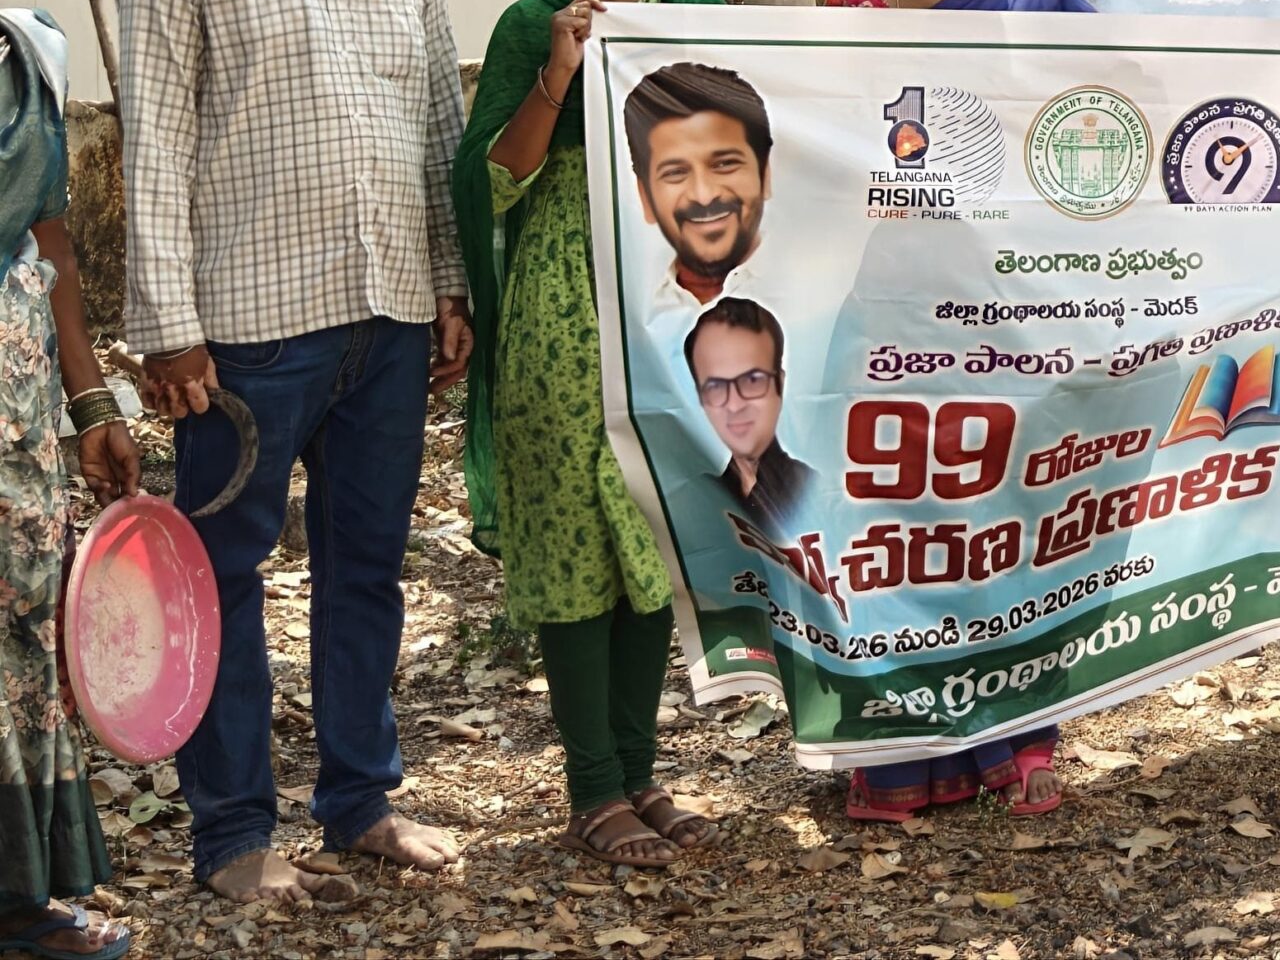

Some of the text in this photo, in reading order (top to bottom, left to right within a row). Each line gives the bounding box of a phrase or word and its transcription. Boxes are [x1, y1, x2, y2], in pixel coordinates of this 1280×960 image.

[1034, 96, 1145, 151] GOVERNMENT OF TELANGANA
[1166, 133, 1184, 165] ప్రజా
[1183, 103, 1221, 134] పాలన
[1232, 101, 1266, 121] ప్రగతి
[868, 188, 955, 207] RISING
[870, 171, 952, 183] TELANGANA
[867, 209, 909, 219] CURE
[922, 210, 962, 220] PURE
[973, 210, 1010, 219] RARE
[995, 247, 1204, 281] తెలంగాణ ప్రభుత్వం
[935, 302, 980, 326] జిల్లా
[982, 299, 1081, 325] గ్రంథాలయ
[1085, 297, 1126, 329] సంస్థ
[1143, 295, 1199, 317] మెదక్
[867, 344, 956, 382] ప్రజా
[963, 344, 1075, 375] పాలన
[1108, 337, 1184, 377] ప్రగతి
[845, 400, 1152, 500] 99 రోజుల
[1032, 445, 1280, 566] ప్రణాళిక
[895, 616, 961, 653] నుండి
[967, 570, 1100, 641] 29.03.2026
[1101, 554, 1155, 587] వరకు
[941, 610, 1142, 718] గ్రంథాలయ
[1150, 574, 1238, 632] సంస్థ
